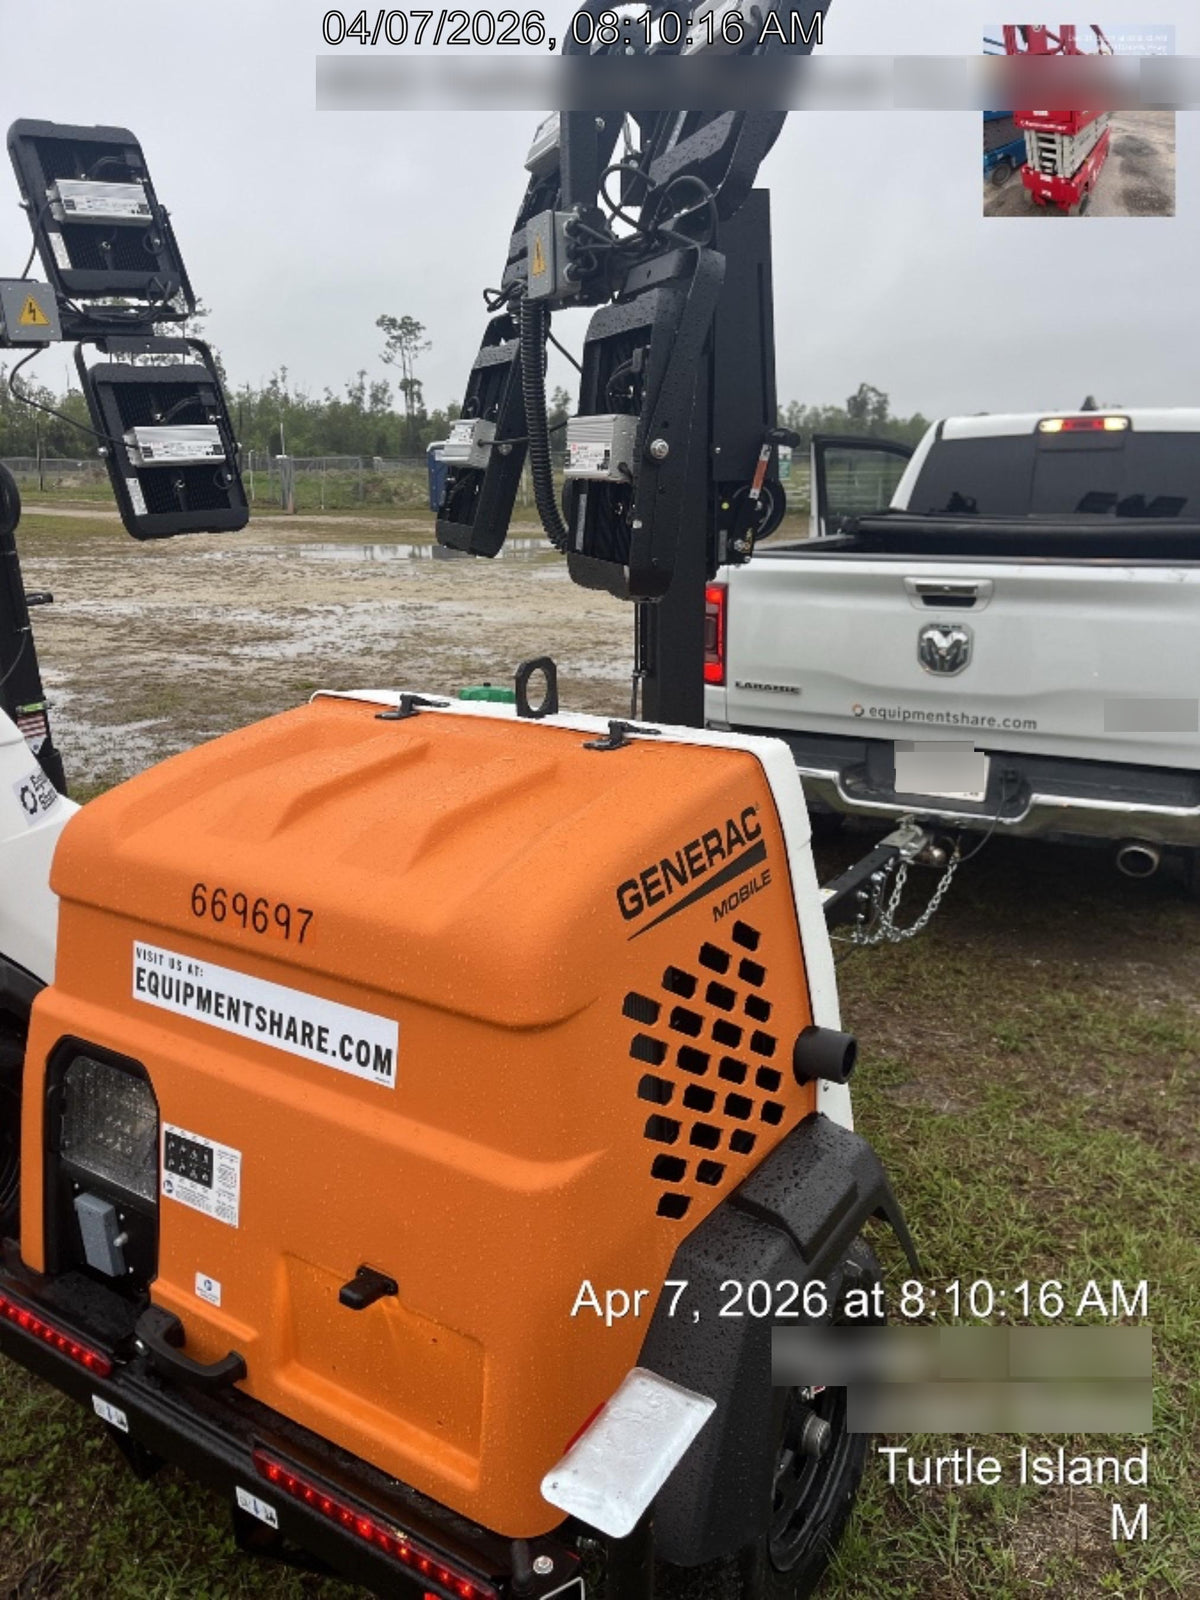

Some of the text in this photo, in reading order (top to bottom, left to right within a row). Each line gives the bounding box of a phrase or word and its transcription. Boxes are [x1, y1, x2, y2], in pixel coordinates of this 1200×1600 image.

[868, 706, 1038, 730] equipmentshare.com
[616, 805, 762, 921] GENERAC
[190, 882, 315, 944] 669697
[711, 868, 773, 923] MOBILE
[136, 947, 204, 977] VISIT US AT:
[135, 966, 393, 1077] EQUIPMENTSHARE.COM
